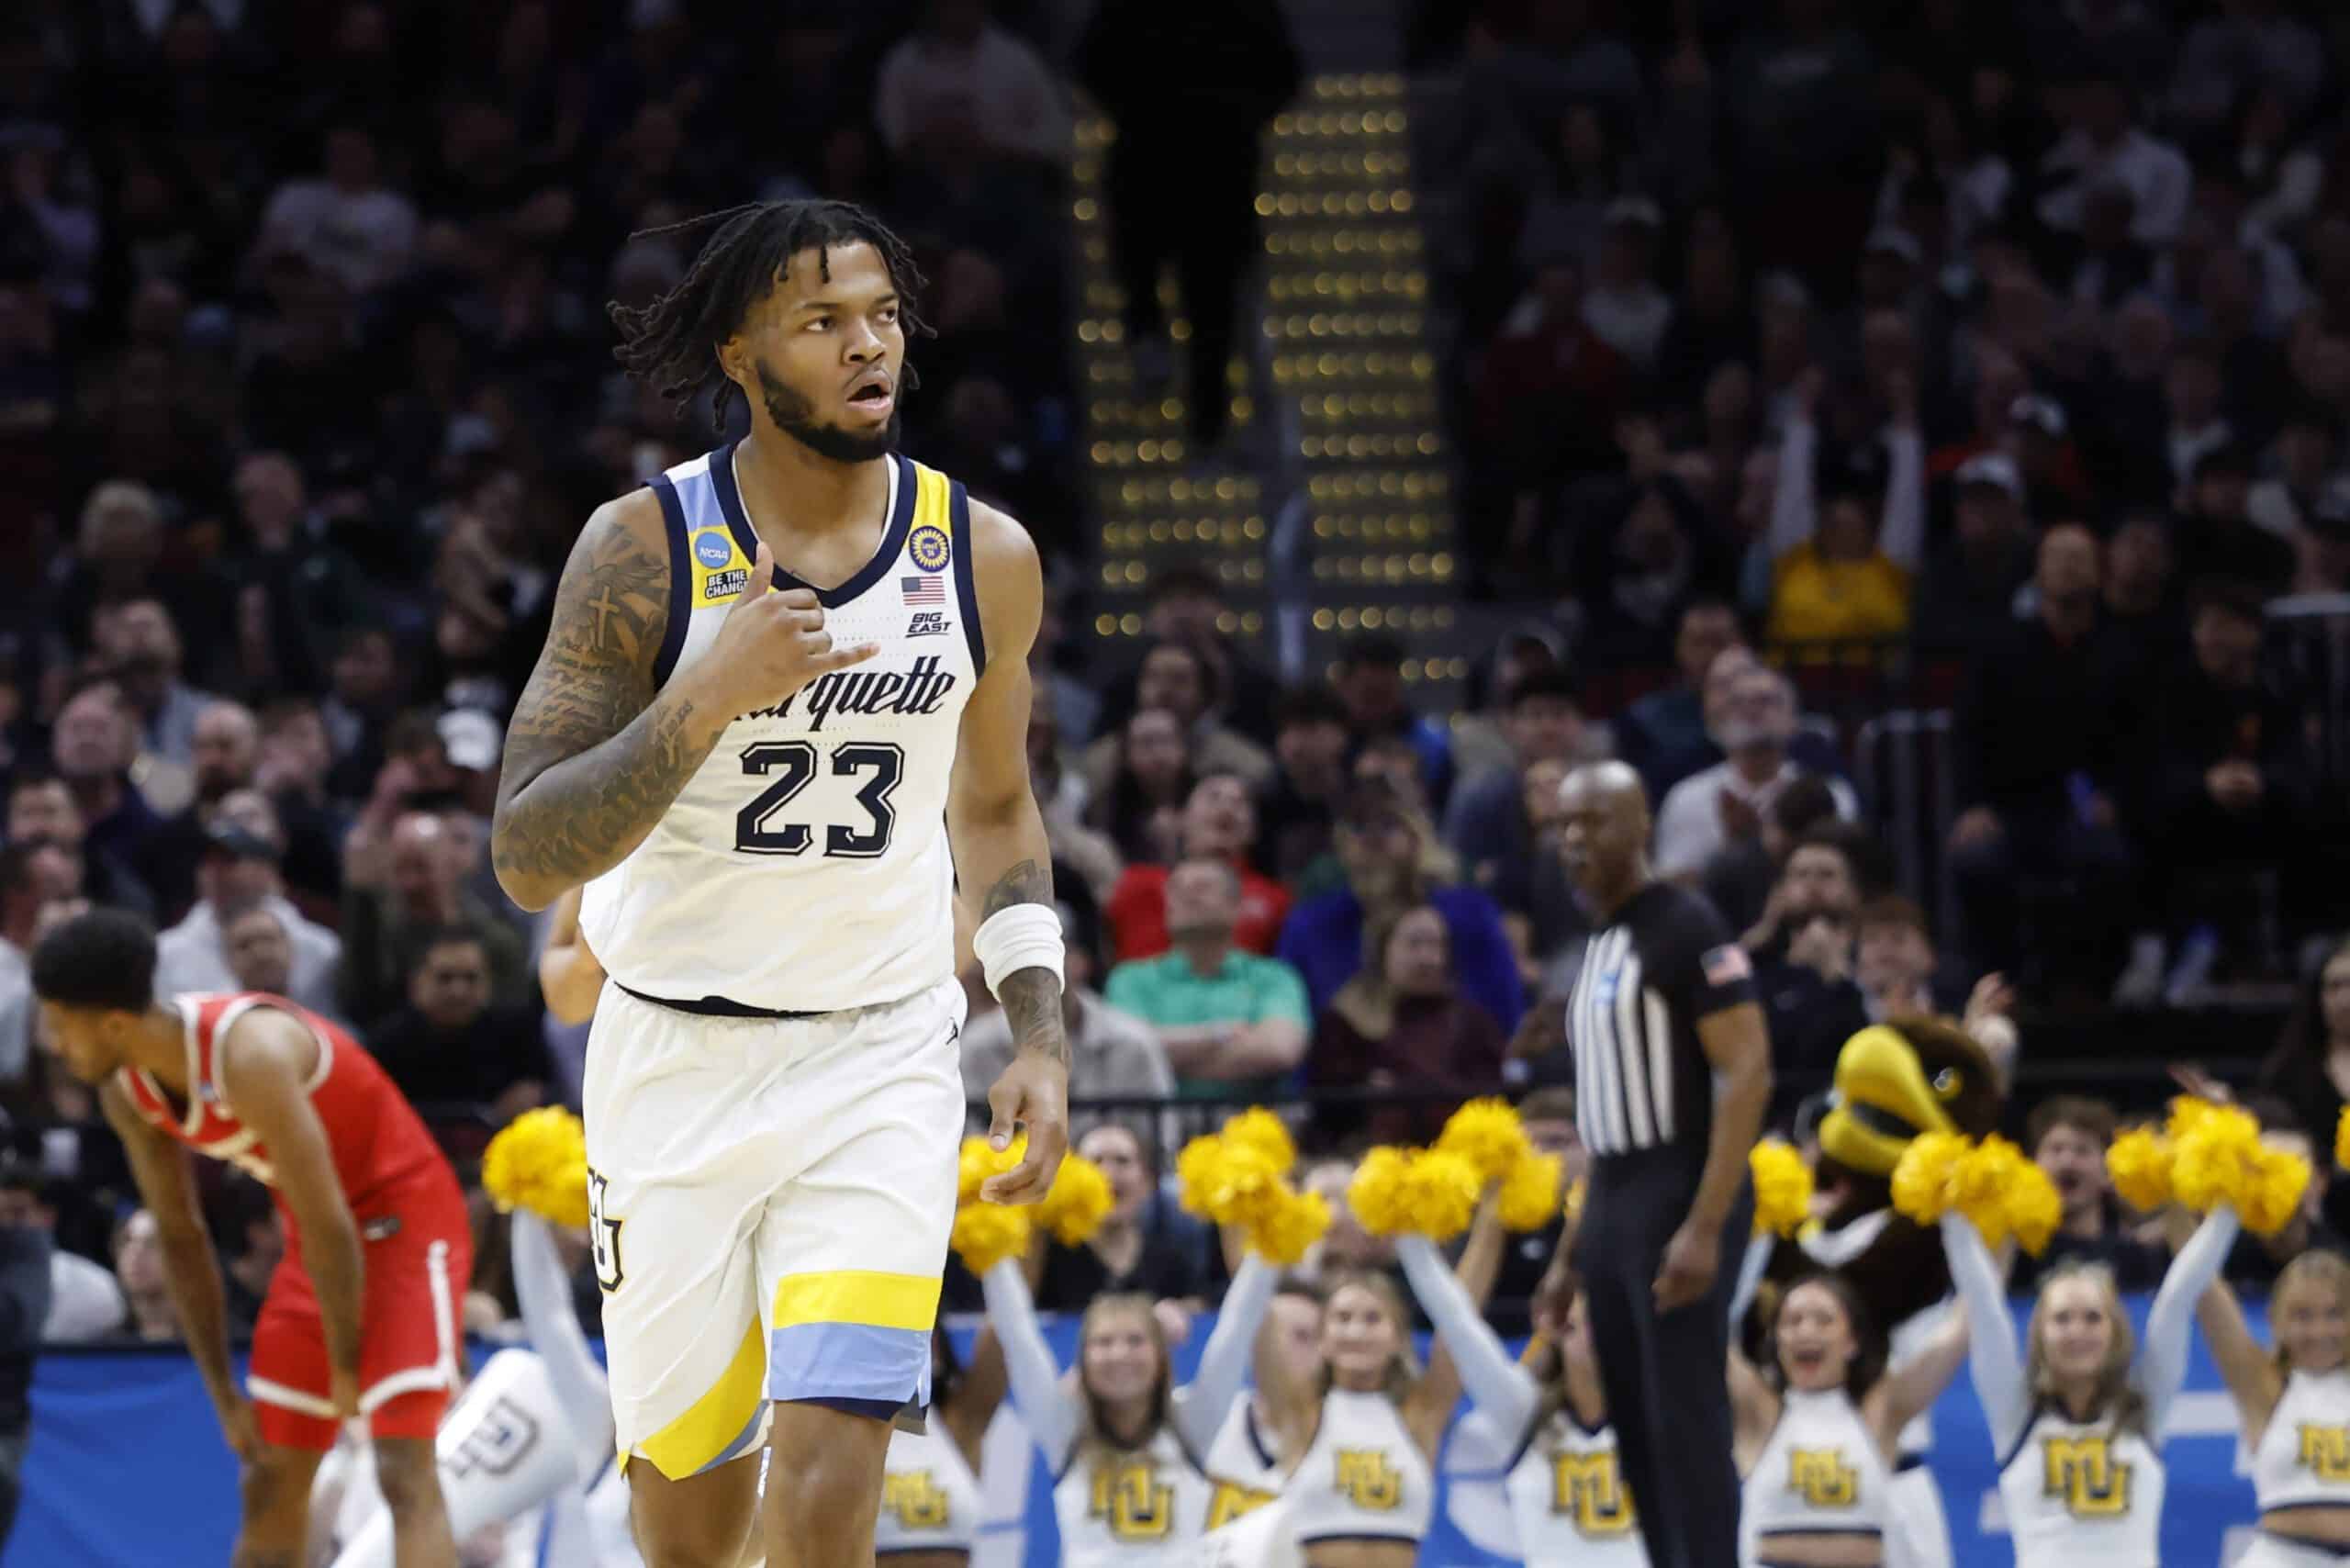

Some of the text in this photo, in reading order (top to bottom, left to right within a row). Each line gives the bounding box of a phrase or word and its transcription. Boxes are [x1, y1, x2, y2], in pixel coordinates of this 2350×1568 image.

[700, 546, 728, 560] NCAA
[708, 569, 746, 588] BE THE
[706, 580, 748, 599] CHANG
[912, 612, 943, 623] BIG
[908, 622, 952, 633] EAST
[733, 740, 905, 857] 23
[1334, 1448, 1404, 1509] MU
[1789, 1448, 1858, 1506] MU
[2043, 1436, 2132, 1518] MU
